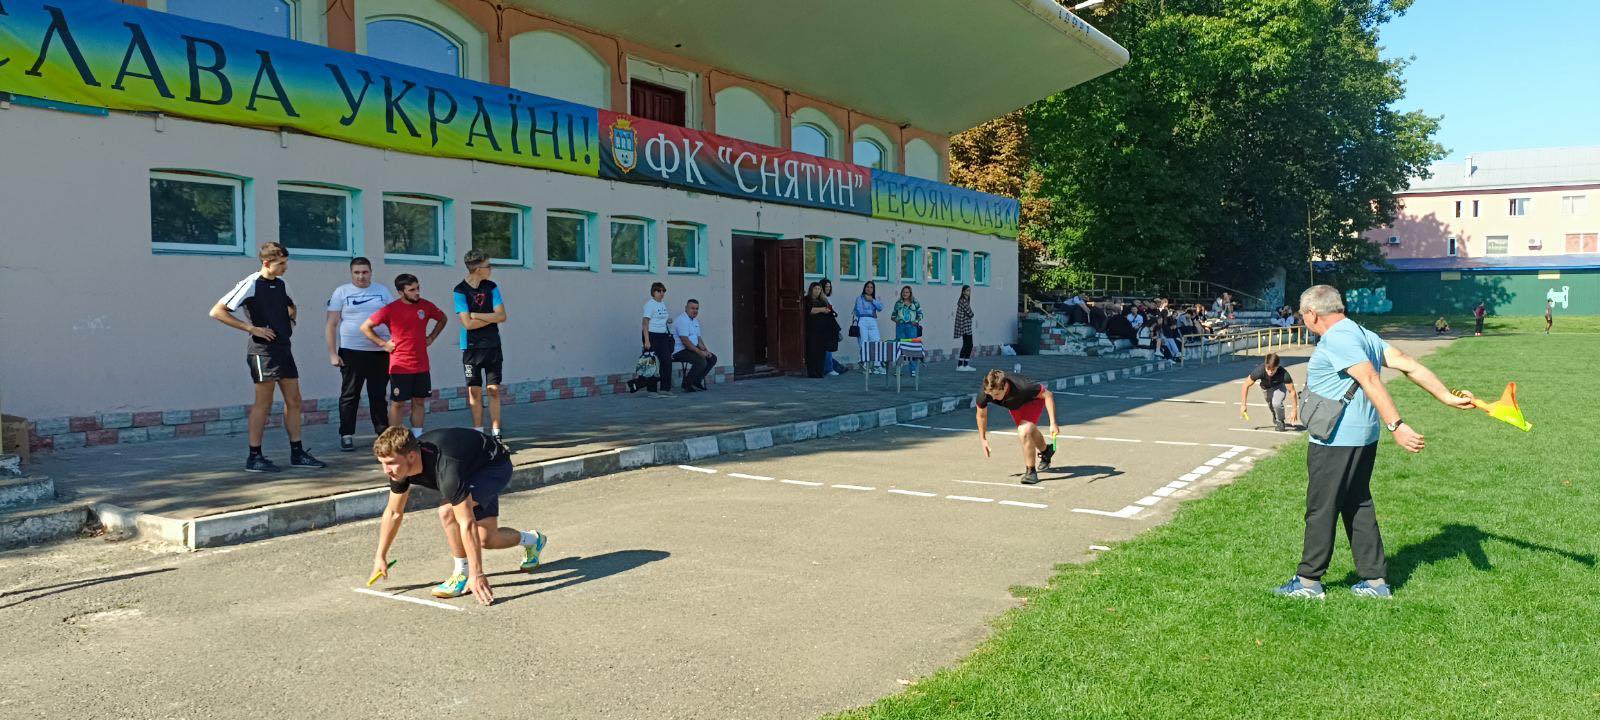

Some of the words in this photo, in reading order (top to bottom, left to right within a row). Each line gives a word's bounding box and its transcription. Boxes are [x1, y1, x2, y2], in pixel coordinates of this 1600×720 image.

[0, 0, 300, 118] ЛАВА
[325, 63, 590, 165] УКРАЇНІ!
[644, 133, 707, 186] ФК
[873, 178, 954, 223] ГЕРОЯМ
